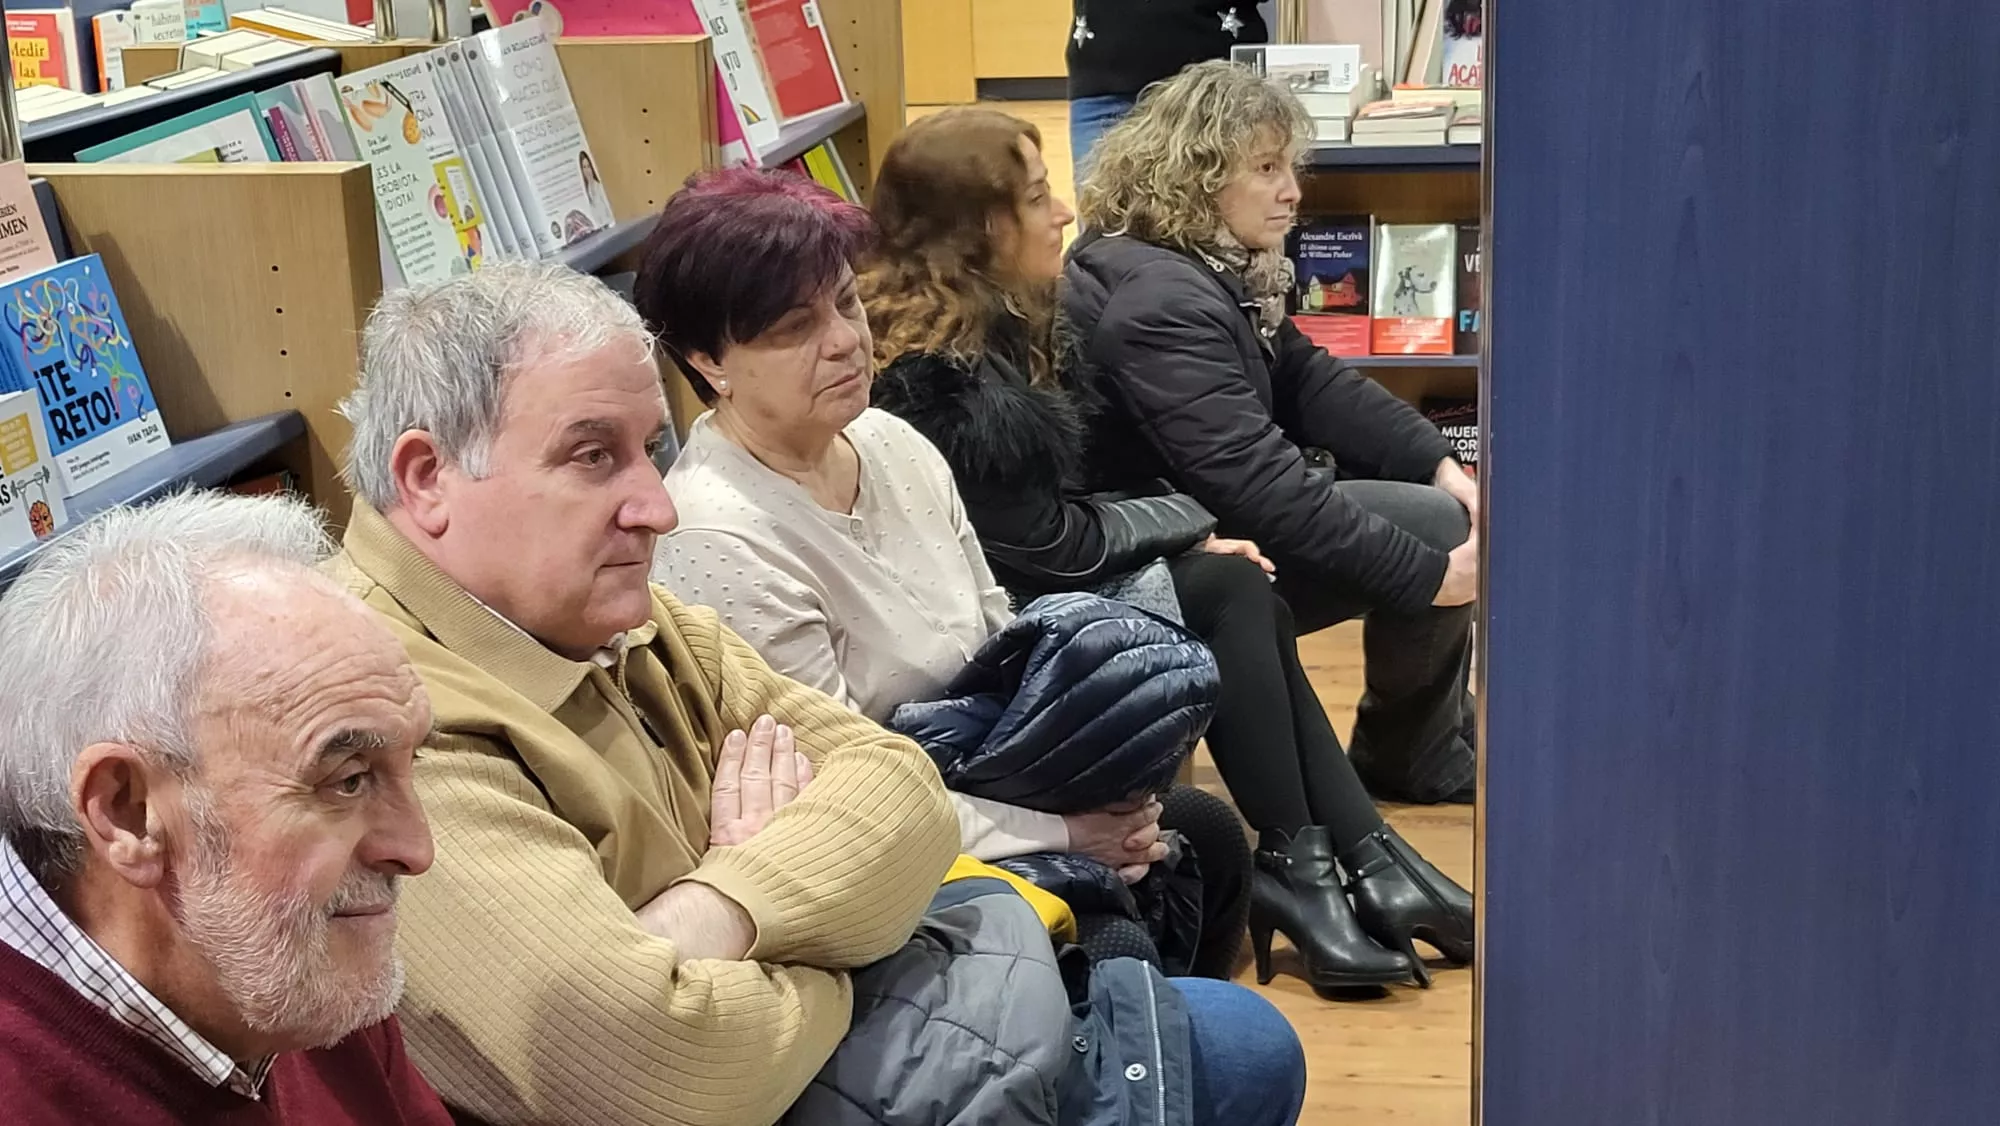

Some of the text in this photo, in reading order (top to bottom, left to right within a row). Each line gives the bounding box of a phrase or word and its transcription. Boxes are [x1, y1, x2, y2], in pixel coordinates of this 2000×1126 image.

[19, 61, 36, 78] las
[1300, 231, 1335, 241] Alexandre
[33, 360, 78, 407] ¡TE
[48, 386, 120, 446] RETO!
